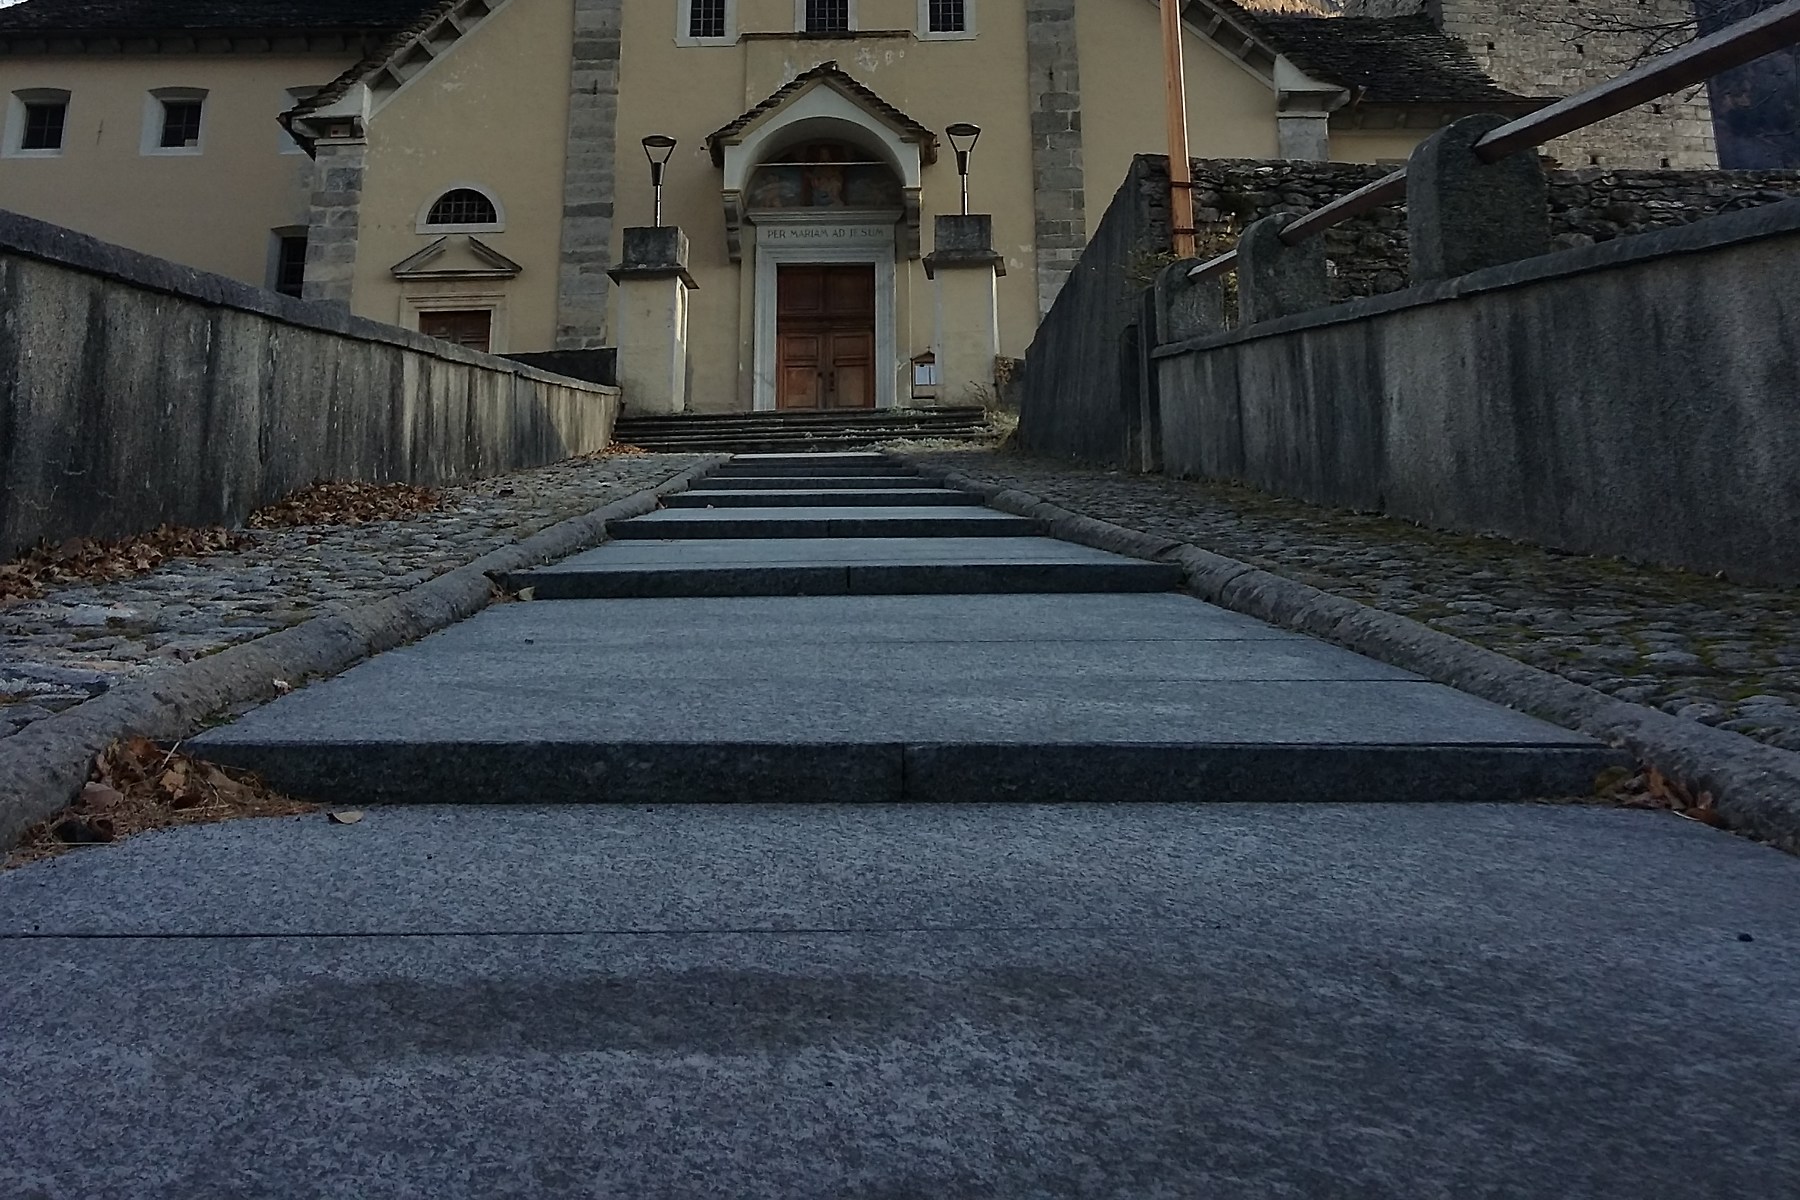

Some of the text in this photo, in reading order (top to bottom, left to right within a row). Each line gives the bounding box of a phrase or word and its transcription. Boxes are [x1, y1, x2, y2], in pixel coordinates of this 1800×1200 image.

[767, 229, 786, 239] PER
[790, 228, 829, 239] MARIAM
[832, 228, 846, 238] AD
